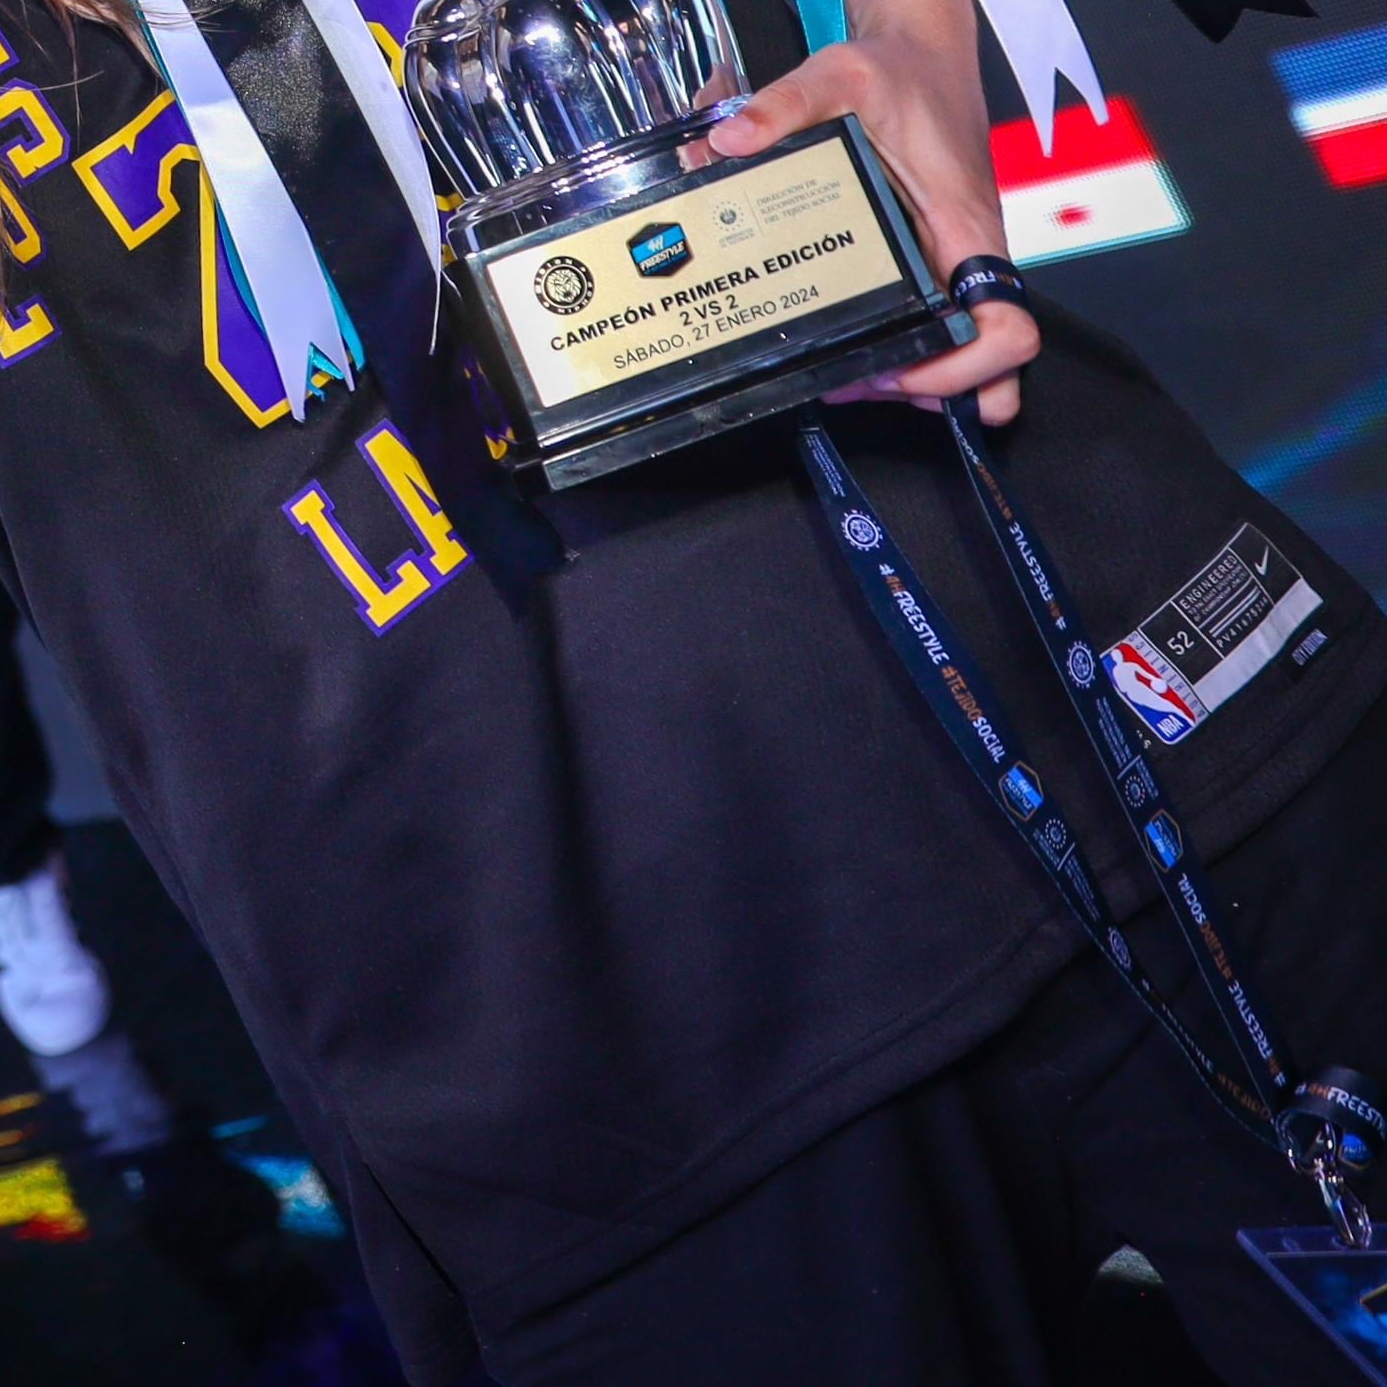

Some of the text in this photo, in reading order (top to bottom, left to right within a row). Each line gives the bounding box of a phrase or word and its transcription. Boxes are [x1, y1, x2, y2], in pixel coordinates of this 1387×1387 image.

[550, 303, 656, 353] CAMPEÓN
[663, 267, 759, 313] PRIMERA
[765, 229, 855, 276] EDICIÓN
[679, 294, 740, 327] 2 VS 2
[613, 284, 820, 370] SÁBADO, 27 ENERO 2024
[1179, 554, 1238, 609] ENGINEERED
[1167, 631, 1194, 656] 52
[1157, 714, 1184, 738] NBA
